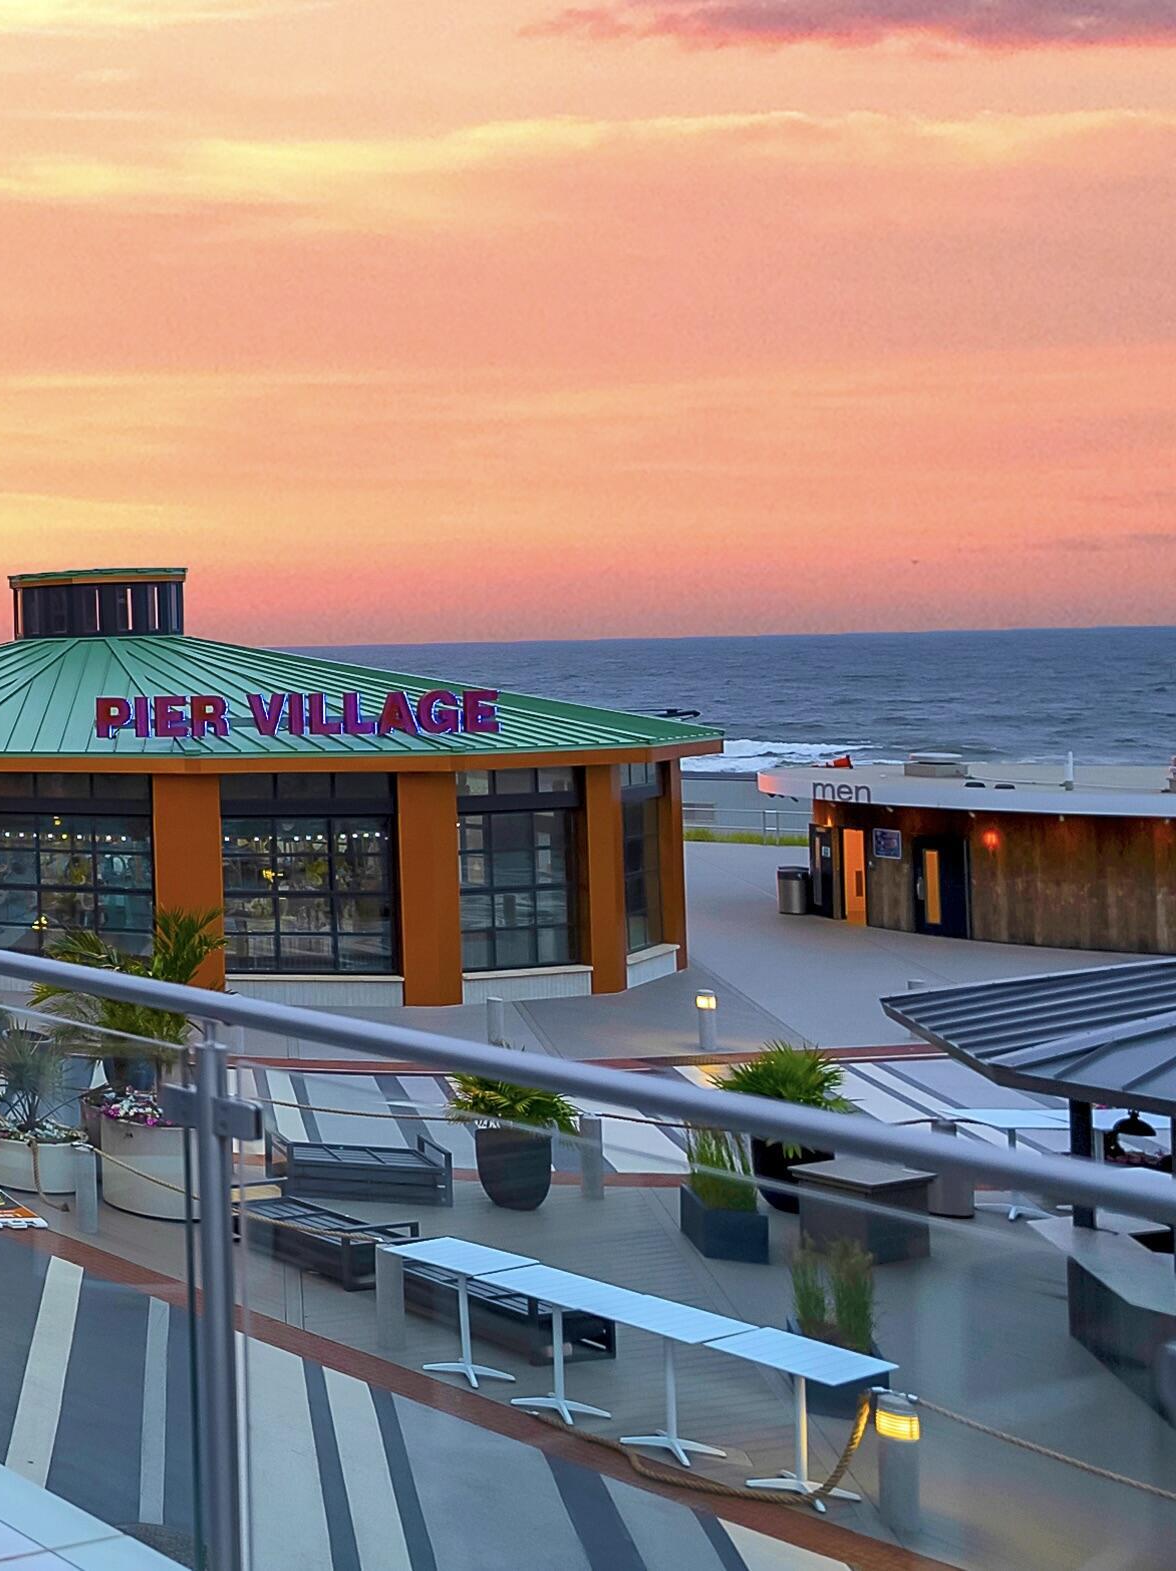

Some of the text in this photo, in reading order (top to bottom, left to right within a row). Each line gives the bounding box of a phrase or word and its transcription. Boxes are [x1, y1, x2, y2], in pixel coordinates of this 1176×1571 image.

[95, 689, 502, 738] PIER VILLAGE
[812, 782, 872, 803] men
